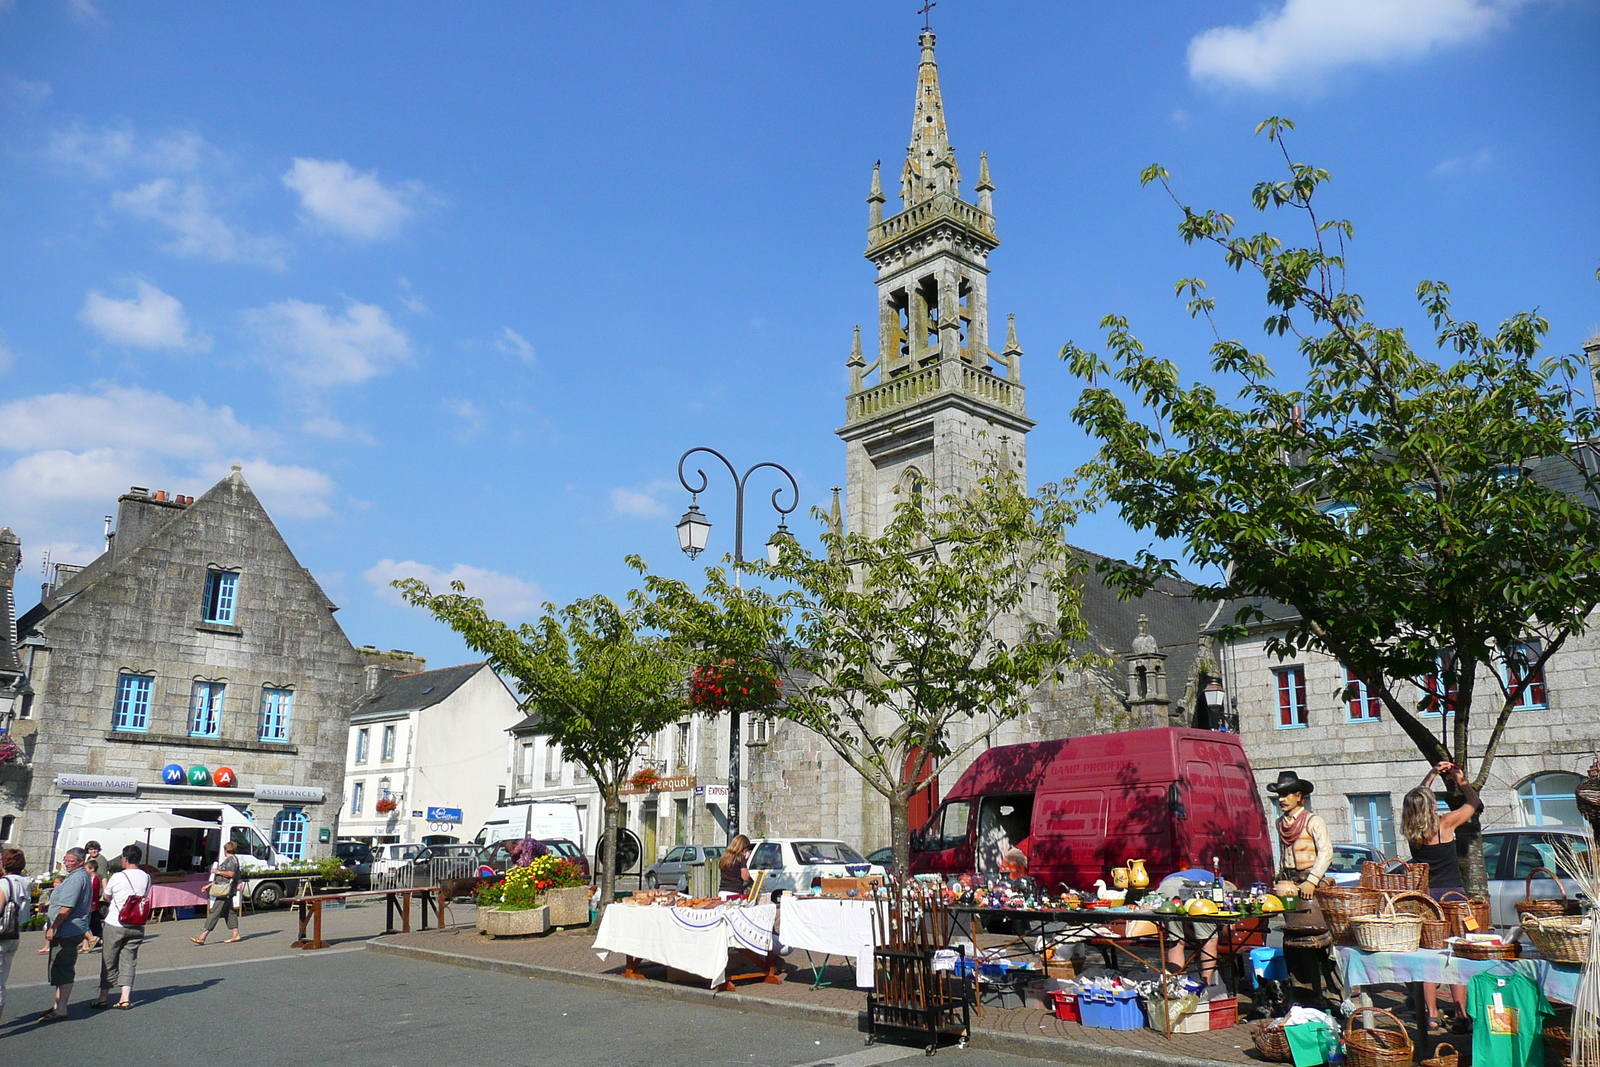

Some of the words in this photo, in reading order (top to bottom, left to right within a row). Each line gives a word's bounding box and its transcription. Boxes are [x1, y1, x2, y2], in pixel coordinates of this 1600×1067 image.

[1051, 764, 1080, 776] DAMP
[61, 777, 103, 787] Sébastien
[105, 780, 135, 789] MARIE
[646, 777, 690, 793] ezequel
[261, 789, 318, 798] ASSURANCES
[708, 786, 730, 796] EXPOSI
